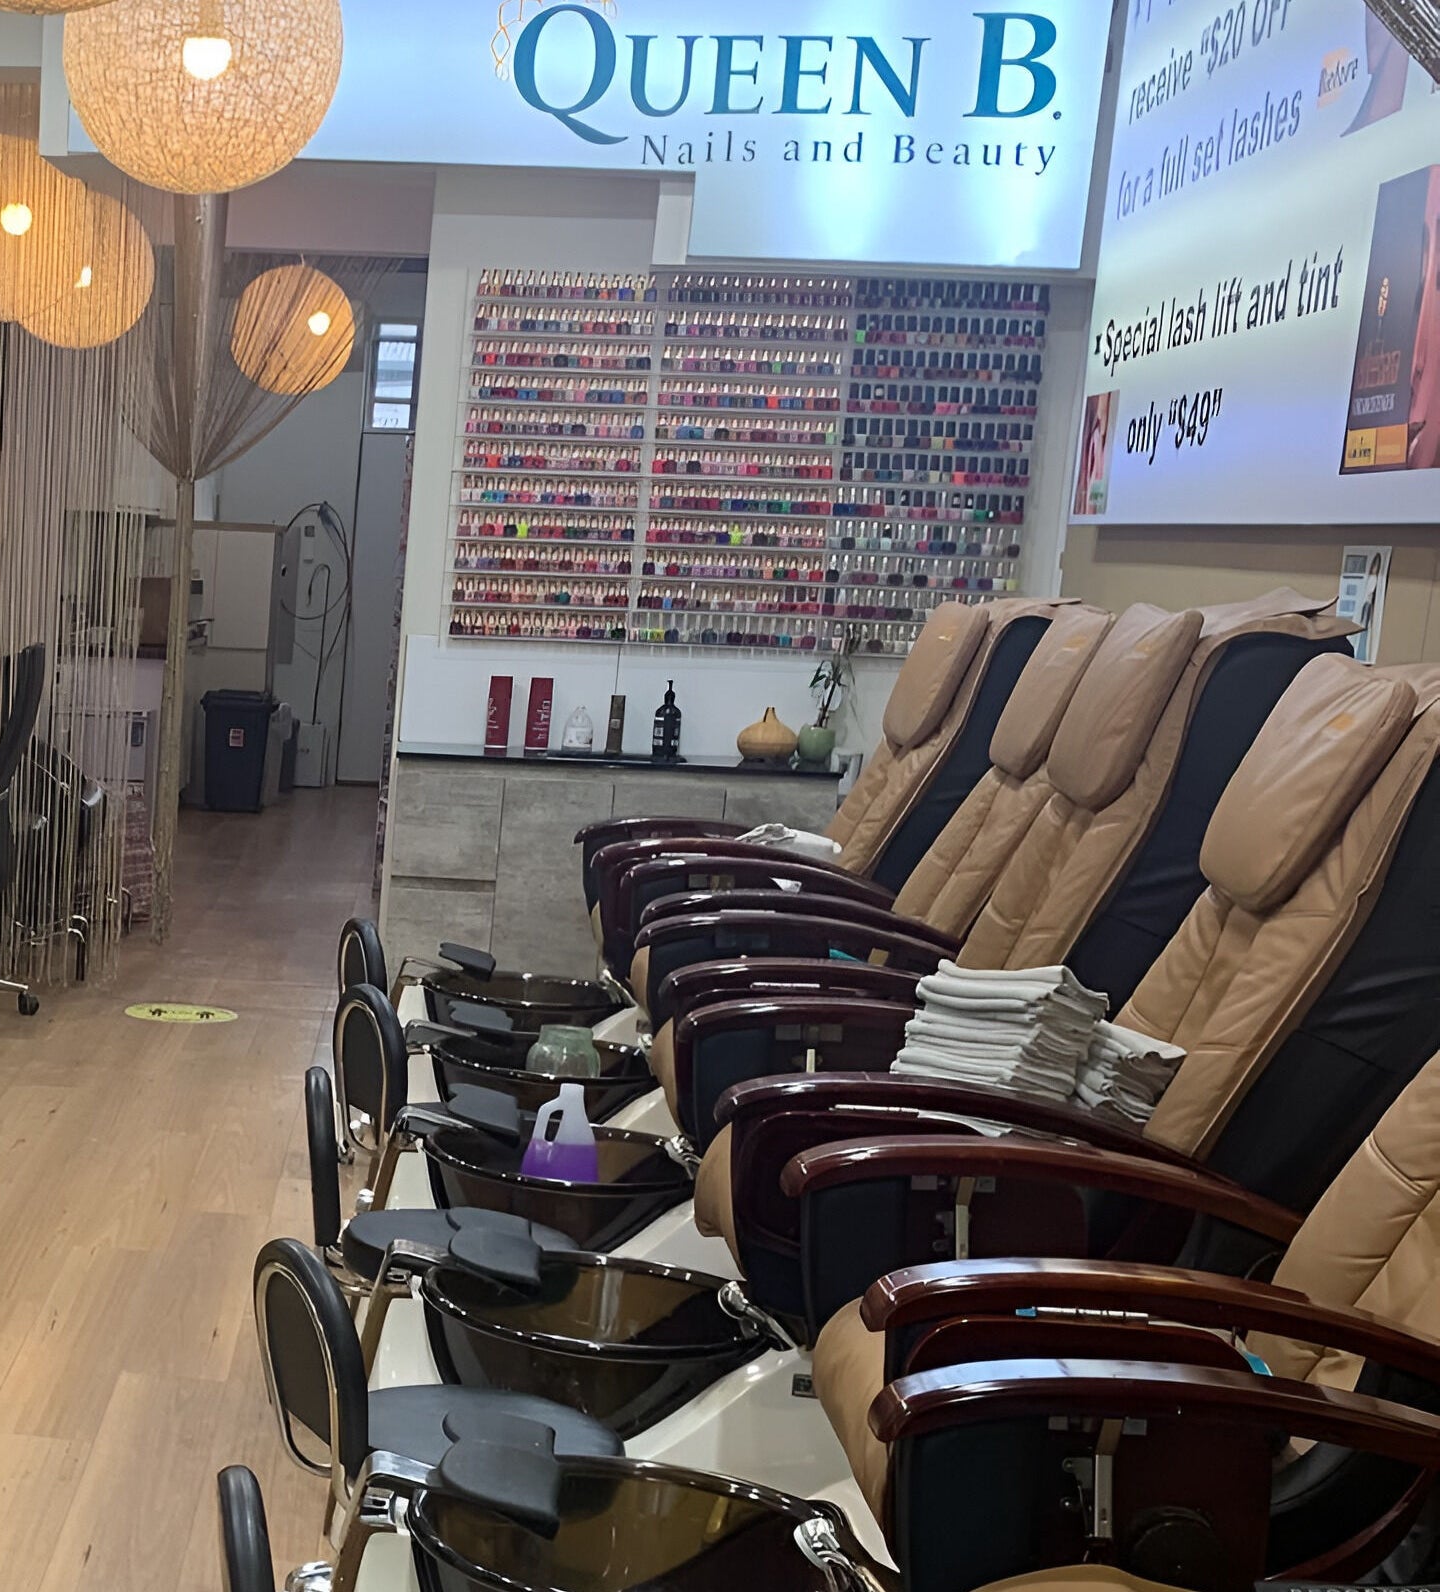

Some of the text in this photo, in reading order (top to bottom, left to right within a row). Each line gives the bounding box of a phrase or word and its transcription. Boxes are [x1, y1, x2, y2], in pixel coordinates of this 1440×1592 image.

[513, 3, 931, 145] QUEEN
[1128, 47, 1193, 126] receive
[642, 131, 1057, 176] Nails and Beauty
[1116, 89, 1302, 221] for a full set lashes
[1103, 243, 1344, 377] Special lash lift and tint
[1127, 401, 1163, 466] only
